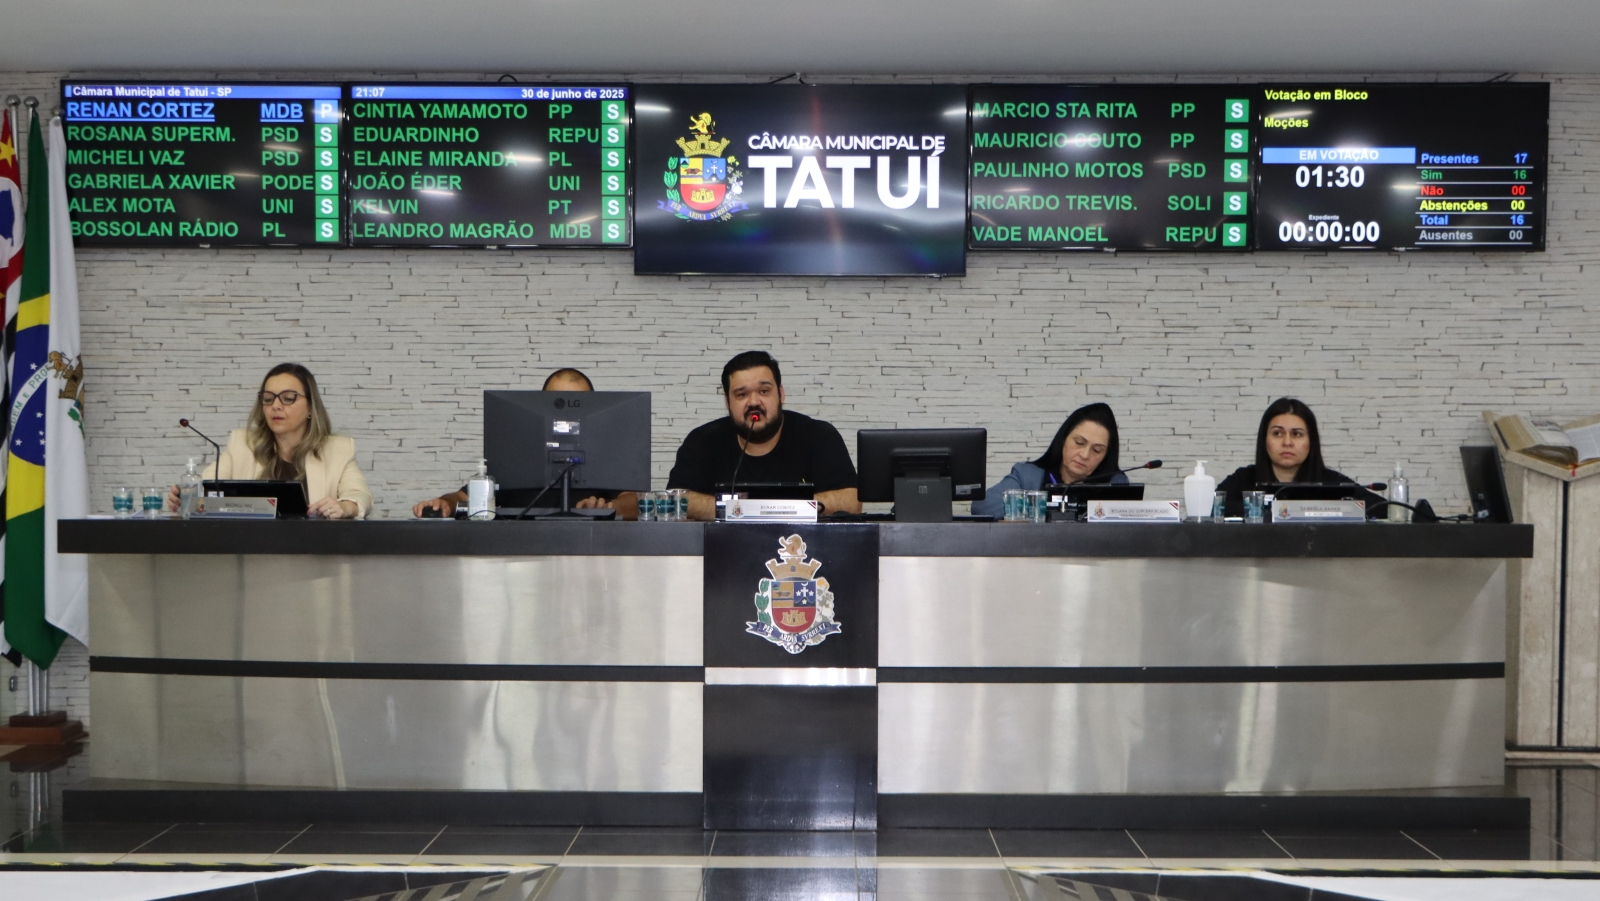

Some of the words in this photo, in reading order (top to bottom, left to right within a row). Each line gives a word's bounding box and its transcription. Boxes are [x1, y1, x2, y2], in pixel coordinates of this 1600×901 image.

[73, 87, 113, 97] Câmara
[115, 87, 165, 98] Municipal
[168, 88, 180, 97] de
[217, 88, 232, 97] SP
[355, 88, 385, 97] 21:07
[522, 90, 534, 98] 30
[536, 90, 549, 98] de
[551, 90, 581, 100] junho
[584, 90, 597, 98] de
[600, 90, 624, 98] 2025
[1265, 90, 1311, 102] Votação
[1335, 90, 1368, 100] Bloco
[67, 103, 133, 118] RENAN
[137, 103, 215, 118] CORTEZ
[261, 104, 303, 118] MDB
[321, 104, 332, 118] P
[353, 104, 415, 119] CINTIA
[419, 104, 527, 119] YAMAMOTO
[549, 105, 572, 119] PP
[607, 104, 619, 119] S
[975, 103, 1050, 118] MARCIO
[1056, 103, 1091, 118] STA
[1096, 103, 1137, 118] RITA
[1171, 104, 1195, 118] PP
[1231, 103, 1243, 118] S
[1264, 117, 1308, 130] Moções
[67, 127, 147, 142] ROSANA
[152, 127, 236, 142] SUPERM.
[262, 128, 299, 142] PSD
[320, 128, 332, 143] S
[354, 128, 479, 142] EDUARDINHO
[549, 128, 599, 143] REPU
[607, 128, 619, 143] S
[748, 132, 823, 150] CÂMARA
[826, 135, 919, 150] MUNICIPAL
[922, 136, 945, 150] DE
[975, 133, 1067, 148] MAURICIO
[1075, 133, 1141, 148] COUTO
[1171, 134, 1194, 148] PP
[1230, 133, 1242, 149] S
[68, 150, 143, 165] MICHELI
[149, 151, 185, 165] VAZ
[262, 151, 299, 166] PSD
[321, 151, 333, 166] S
[355, 152, 422, 166] ELAINE
[430, 152, 517, 166] MIRANDA
[549, 152, 572, 166] PL
[607, 152, 619, 167] S
[1300, 150, 1318, 160] EM
[1320, 149, 1379, 162] VOTAÇÃO
[1421, 154, 1479, 164] Presentes
[1514, 154, 1528, 163] 17
[974, 163, 1069, 178] PAULINHO
[1075, 163, 1143, 178] MOTOS
[1169, 164, 1206, 178] PSD
[1230, 163, 1242, 179] S
[1296, 166, 1364, 187] 01:30
[1421, 170, 1442, 180] Sim
[1514, 170, 1526, 179] 16
[69, 174, 164, 189] GABRIELA
[169, 175, 235, 189] XAVIER
[263, 175, 314, 190] PODE
[321, 175, 333, 190] S
[353, 172, 405, 190] JOÃO
[411, 172, 462, 190] ÉDER
[549, 176, 580, 190] UNI
[607, 176, 619, 191] S
[748, 150, 945, 209] TATUÍ
[1421, 186, 1443, 196] Não
[1512, 186, 1525, 195] 00
[69, 198, 117, 213] ALEX
[123, 198, 175, 213] MOTA
[263, 199, 293, 213] UNI
[321, 199, 333, 214] S
[353, 200, 418, 214] KELVIN
[549, 200, 572, 214] PT
[607, 200, 619, 215] S
[974, 195, 1060, 210] RICARDO
[1066, 196, 1137, 211] TREVIS.
[1168, 196, 1210, 211] SOLI
[1229, 195, 1241, 211] S
[1420, 200, 1488, 212] Abstenções
[1511, 201, 1525, 210] 00
[72, 222, 173, 237] BOSSOLAN
[180, 218, 238, 237] RÁDIO
[1421, 215, 1448, 225] Total
[1510, 215, 1524, 225] 16
[263, 222, 285, 237] PL
[321, 222, 333, 237] S
[353, 223, 443, 238] LEANDRO
[450, 220, 534, 239] MAGRÃO
[550, 225, 591, 239] MDB
[607, 224, 619, 239] S
[973, 227, 1021, 241] VADE
[1028, 227, 1108, 242] MANOEL
[1166, 228, 1216, 242] REPU
[1229, 227, 1241, 242] S
[1279, 221, 1380, 242] 00:00:00
[1420, 230, 1473, 240] Ausentes
[1509, 230, 1522, 240] 00
[568, 400, 580, 408] LG
[763, 625, 773, 635] PER
